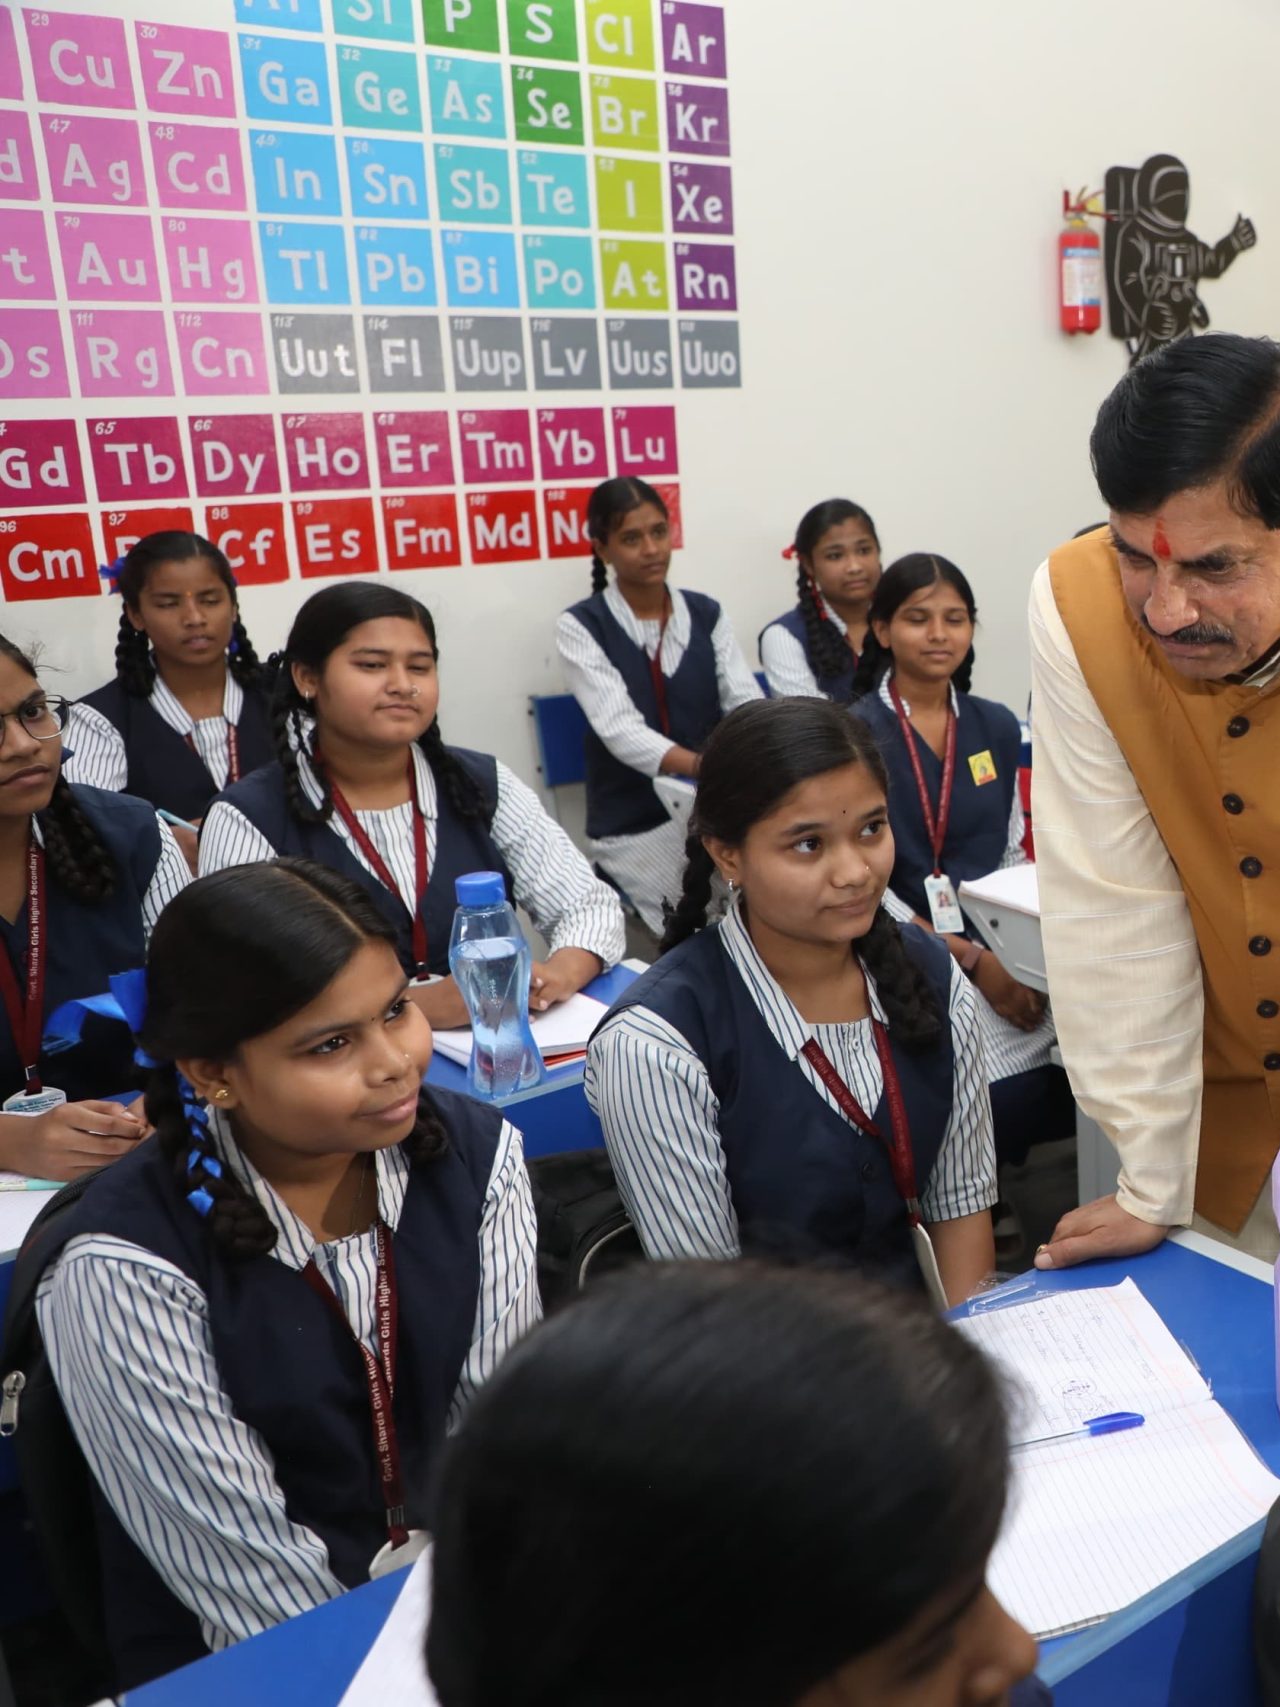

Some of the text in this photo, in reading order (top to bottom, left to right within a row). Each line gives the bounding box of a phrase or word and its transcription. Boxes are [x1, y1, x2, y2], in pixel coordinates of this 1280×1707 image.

[31, 12, 49, 26] 29
[140, 25, 157, 39] 30
[444, 0, 471, 32] P
[526, 4, 552, 43] S
[595, 14, 633, 55] Cl
[243, 37, 261, 50] 31
[672, 24, 715, 64] Ar
[50, 40, 115, 88] Cu
[153, 50, 222, 98] Zn
[259, 61, 319, 105] Ga
[355, 71, 408, 115] Ge
[443, 80, 492, 122] As
[49, 118, 71, 133] 47
[528, 89, 571, 129] Se
[598, 96, 646, 135] Br
[676, 103, 718, 142] Kr
[155, 125, 175, 141] 48
[255, 133, 276, 148] 49
[64, 144, 131, 201] Ag
[168, 152, 230, 194] Cd
[276, 158, 321, 200] In
[364, 164, 416, 204] Sn
[451, 170, 499, 209] Sb
[527, 174, 575, 214] Te
[677, 184, 722, 223] Xe
[63, 215, 80, 228] 79
[168, 219, 187, 232] 80
[266, 223, 283, 236] 81
[79, 242, 146, 285] Au
[179, 247, 245, 299] Hg
[367, 253, 425, 292] Pb
[456, 256, 498, 293] Bi
[534, 259, 583, 295] Po
[613, 262, 661, 297] At
[683, 264, 728, 299] Rn
[76, 313, 93, 327] 111
[179, 313, 201, 327] 112
[274, 315, 295, 328] 113
[368, 317, 389, 331] 114
[453, 318, 475, 331] 115
[87, 337, 158, 388] Rg
[192, 337, 254, 377] Cn
[280, 339, 355, 377] Uut
[382, 339, 422, 376] Fl
[457, 339, 520, 385] Uup
[542, 340, 586, 376] Lv
[611, 341, 667, 376] Uus
[684, 341, 736, 375] Uuo
[94, 421, 117, 435] 65
[193, 419, 213, 432] 66
[286, 416, 306, 429] 67
[296, 437, 359, 476] Ho
[387, 435, 438, 473] Er
[466, 432, 524, 468] Tm
[545, 430, 594, 465] Yb
[621, 428, 664, 462] Lu
[0, 446, 69, 488] Gd
[104, 444, 175, 485] Tb
[203, 441, 264, 493] Dy
[0, 520, 17, 533] 96
[108, 512, 127, 526] 97
[211, 506, 229, 520] 98
[296, 503, 313, 516] 99
[218, 529, 274, 567] Cf
[306, 524, 359, 561] Es
[395, 519, 451, 556] Fm
[475, 513, 531, 549] Md
[9, 542, 83, 581] Cm
[31, 926, 39, 946] Girls
[378, 1270, 392, 1308] Higher
[381, 1310, 391, 1339] Girls
[371, 1381, 383, 1410] Girls
[377, 1411, 390, 1453] Sharda
